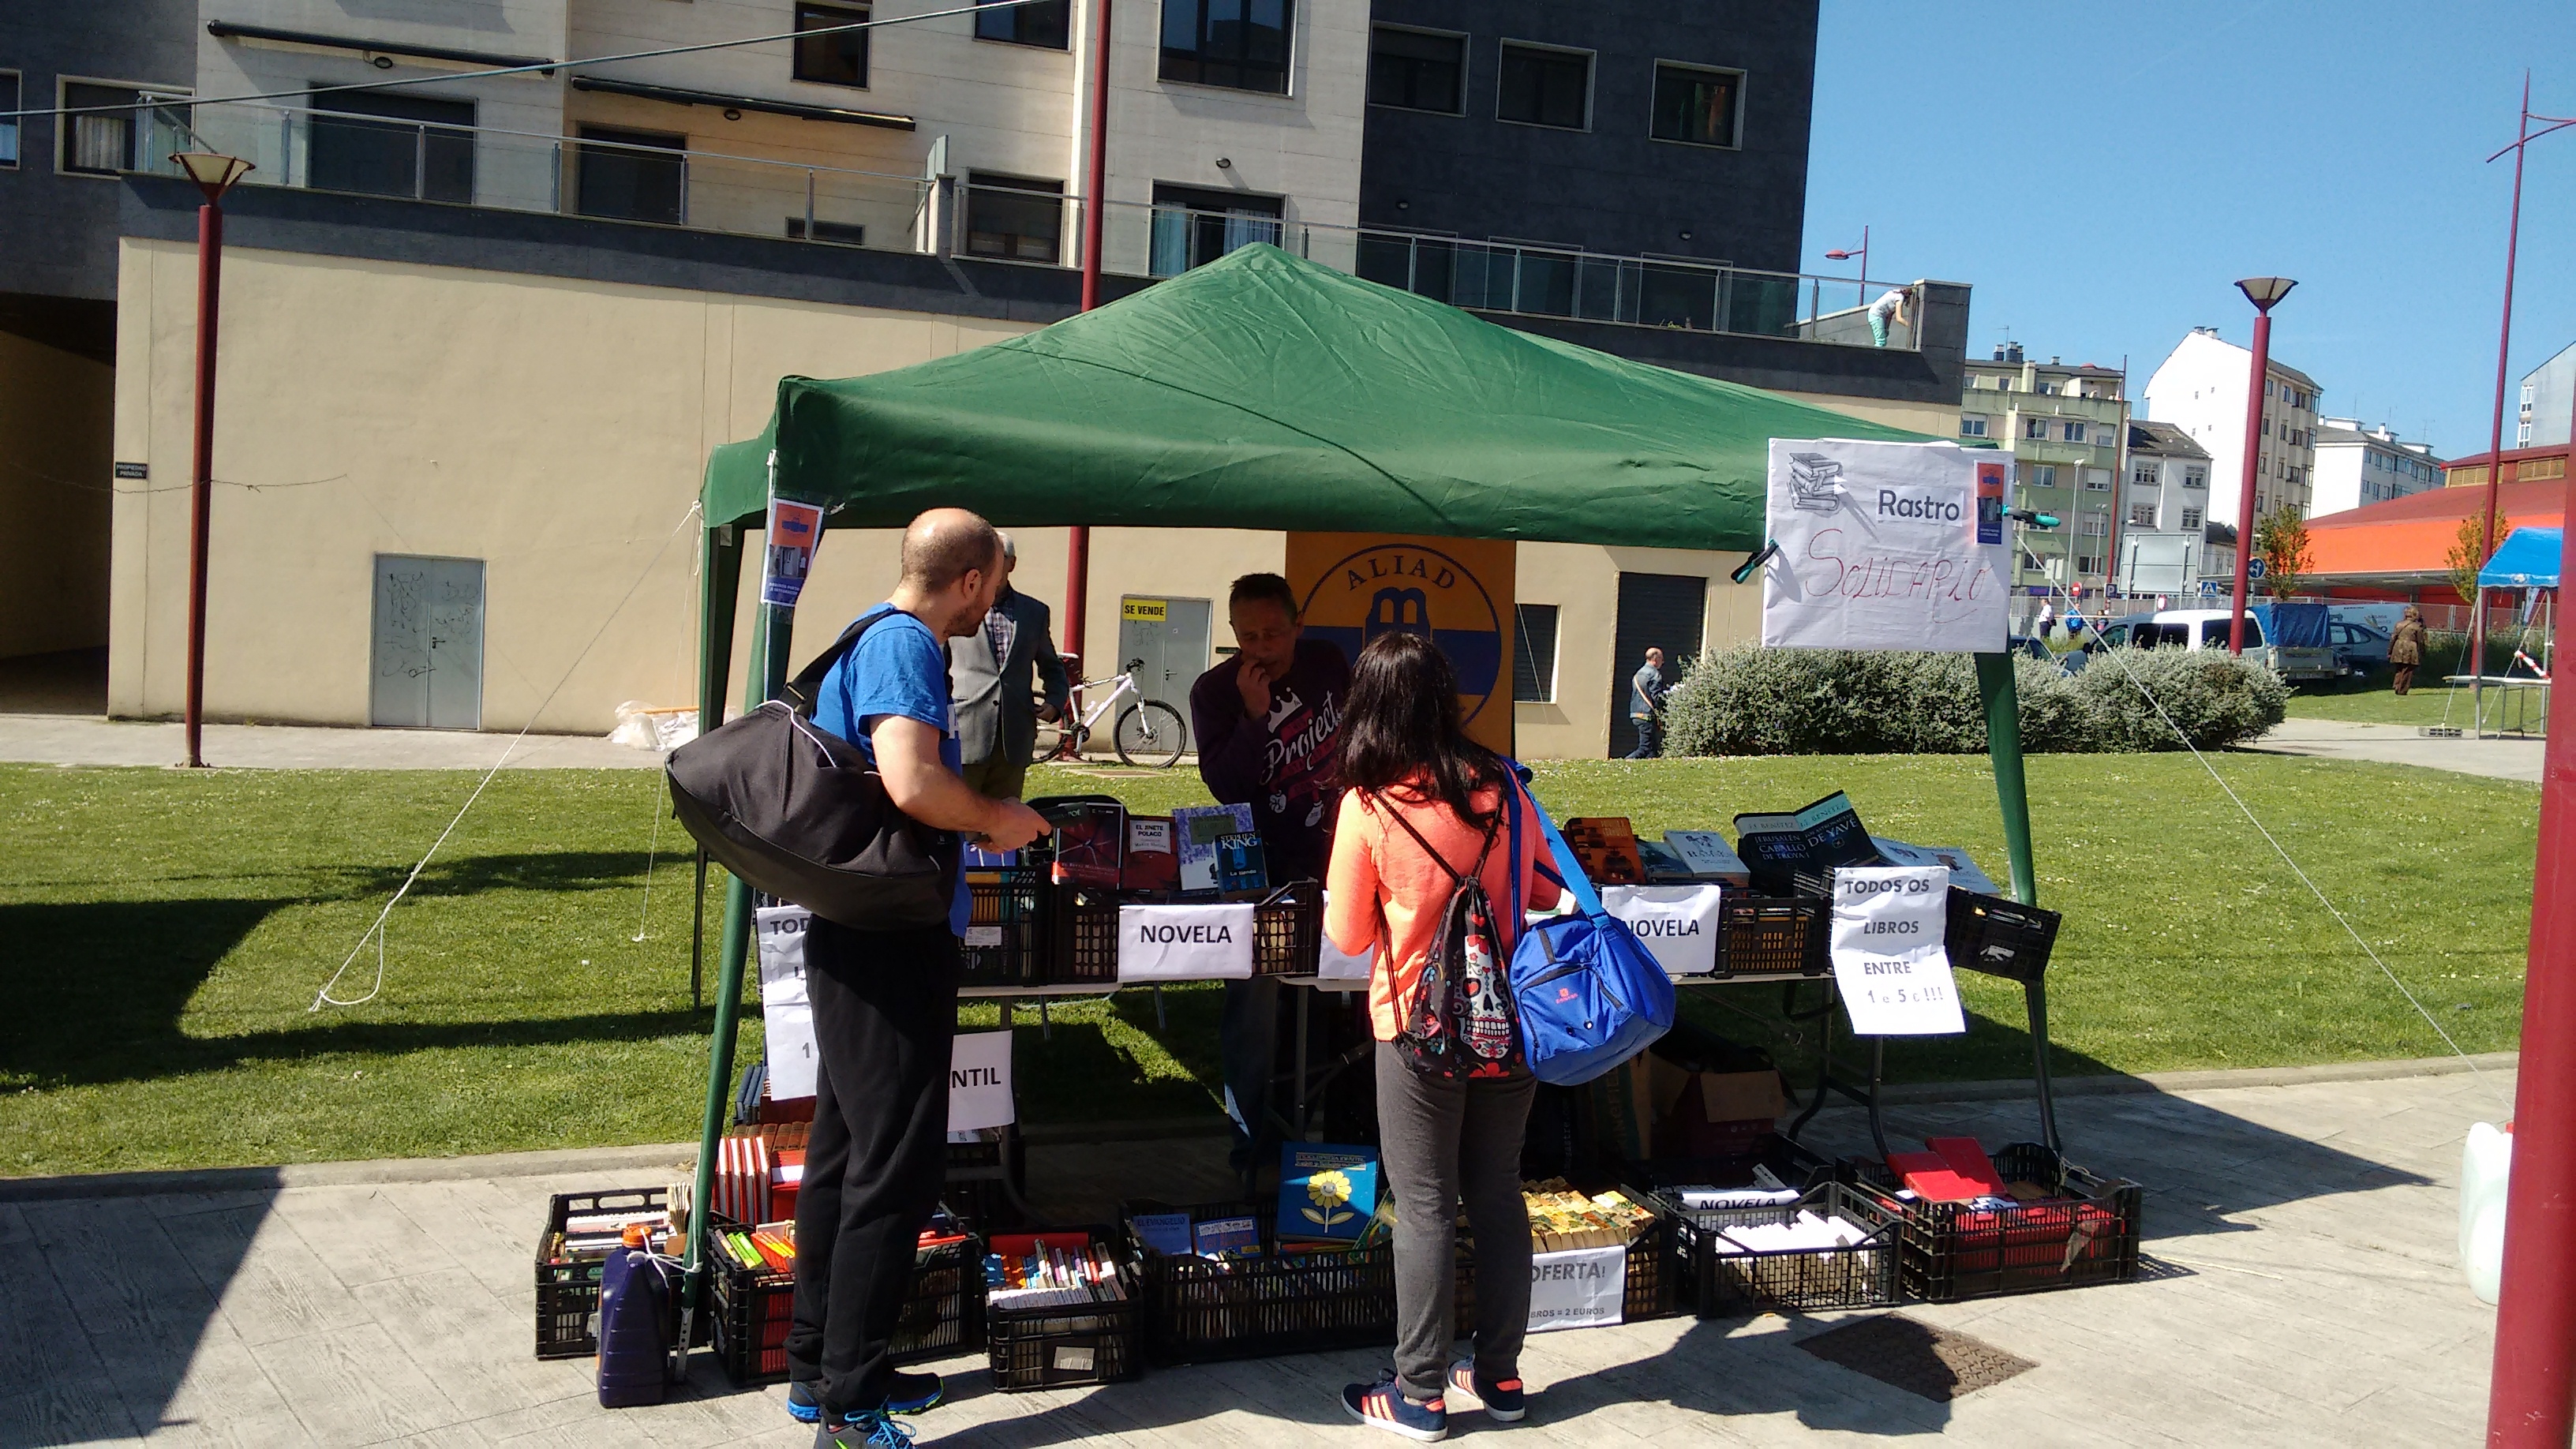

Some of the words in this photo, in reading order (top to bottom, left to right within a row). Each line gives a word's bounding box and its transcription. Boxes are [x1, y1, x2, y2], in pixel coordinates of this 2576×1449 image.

[1878, 489, 1960, 522] Rastro
[1124, 605, 1135, 614] SE
[1137, 605, 1164, 616] VENDE
[1220, 833, 1256, 842] STEPHEN
[1222, 837, 1258, 850] KING
[1807, 833, 1826, 848] DE
[1758, 843, 1807, 853] CABALLO
[1776, 852, 1805, 860] TROYA
[1844, 878, 1902, 895] TODOS
[1908, 878, 1930, 893] OS
[1140, 924, 1233, 945] NOVELA
[1863, 920, 1919, 936] LIBROS
[1864, 960, 1911, 975] ENTRE
[1867, 989, 1876, 1004] 1
[1897, 988, 1907, 1003] 5
[1699, 1197, 1777, 1211] NOVELA
[1147, 1217, 1185, 1226] EVANGELIO
[1564, 1308, 1571, 1316] 2
[1573, 1307, 1605, 1316] EUROS
